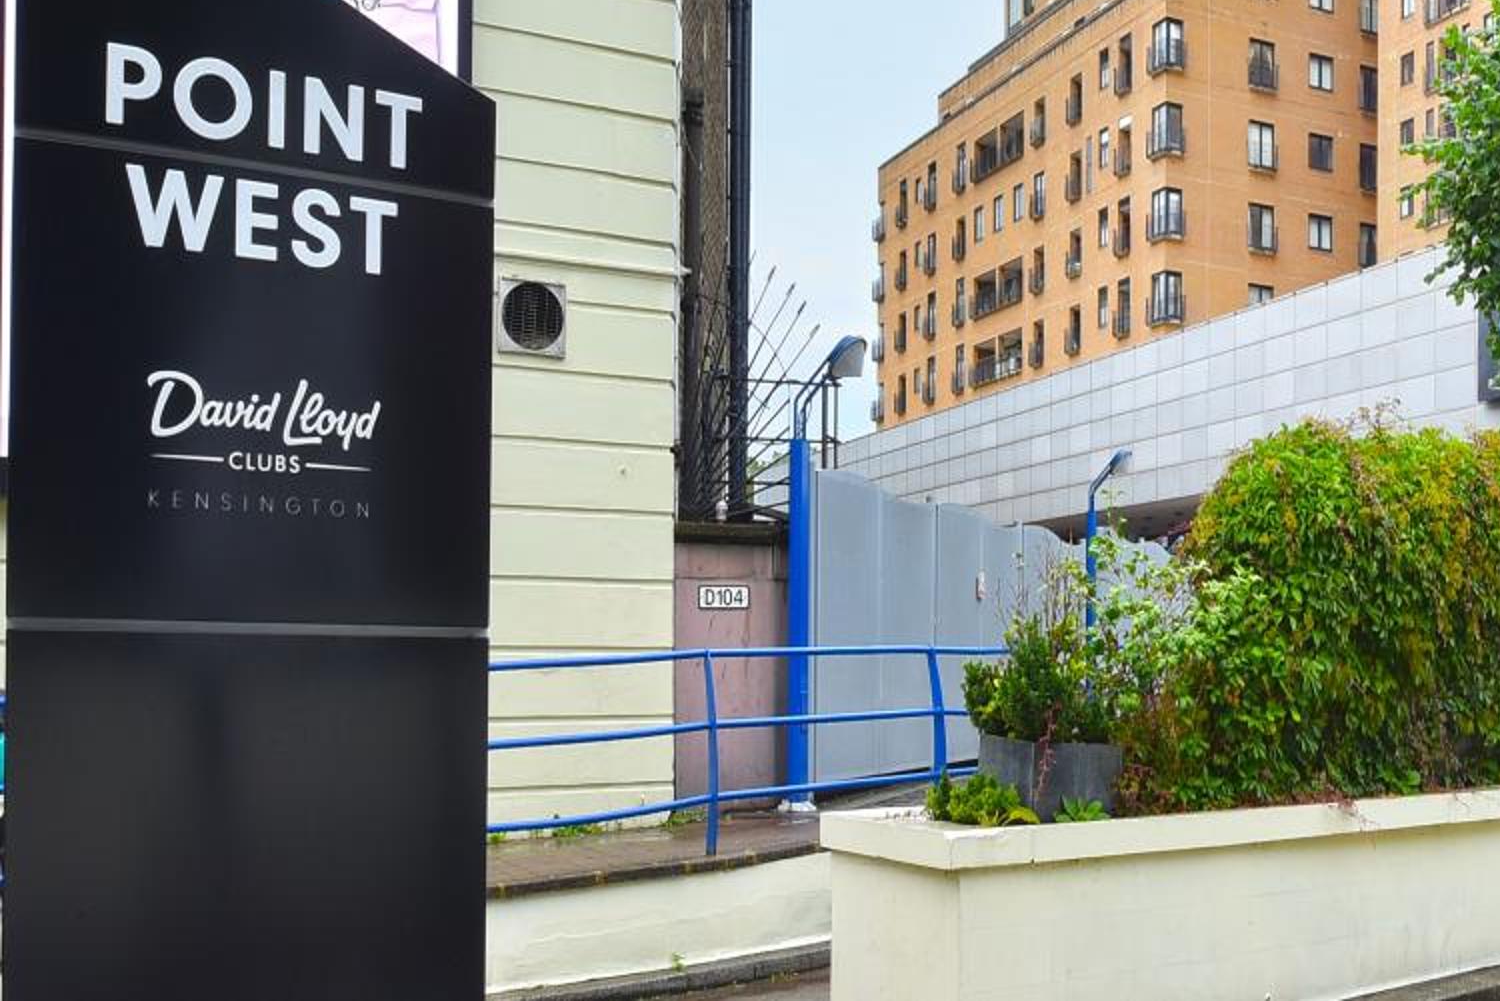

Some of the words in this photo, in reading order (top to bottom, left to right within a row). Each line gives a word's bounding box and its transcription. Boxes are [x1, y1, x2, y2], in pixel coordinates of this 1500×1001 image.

[105, 42, 423, 169] POINT
[125, 163, 398, 275] WEST
[147, 370, 281, 438] David
[283, 378, 381, 451] Lloyd
[228, 452, 300, 474] CLUBS
[147, 489, 371, 519] KENSINGTON
[704, 588, 744, 606] D104
